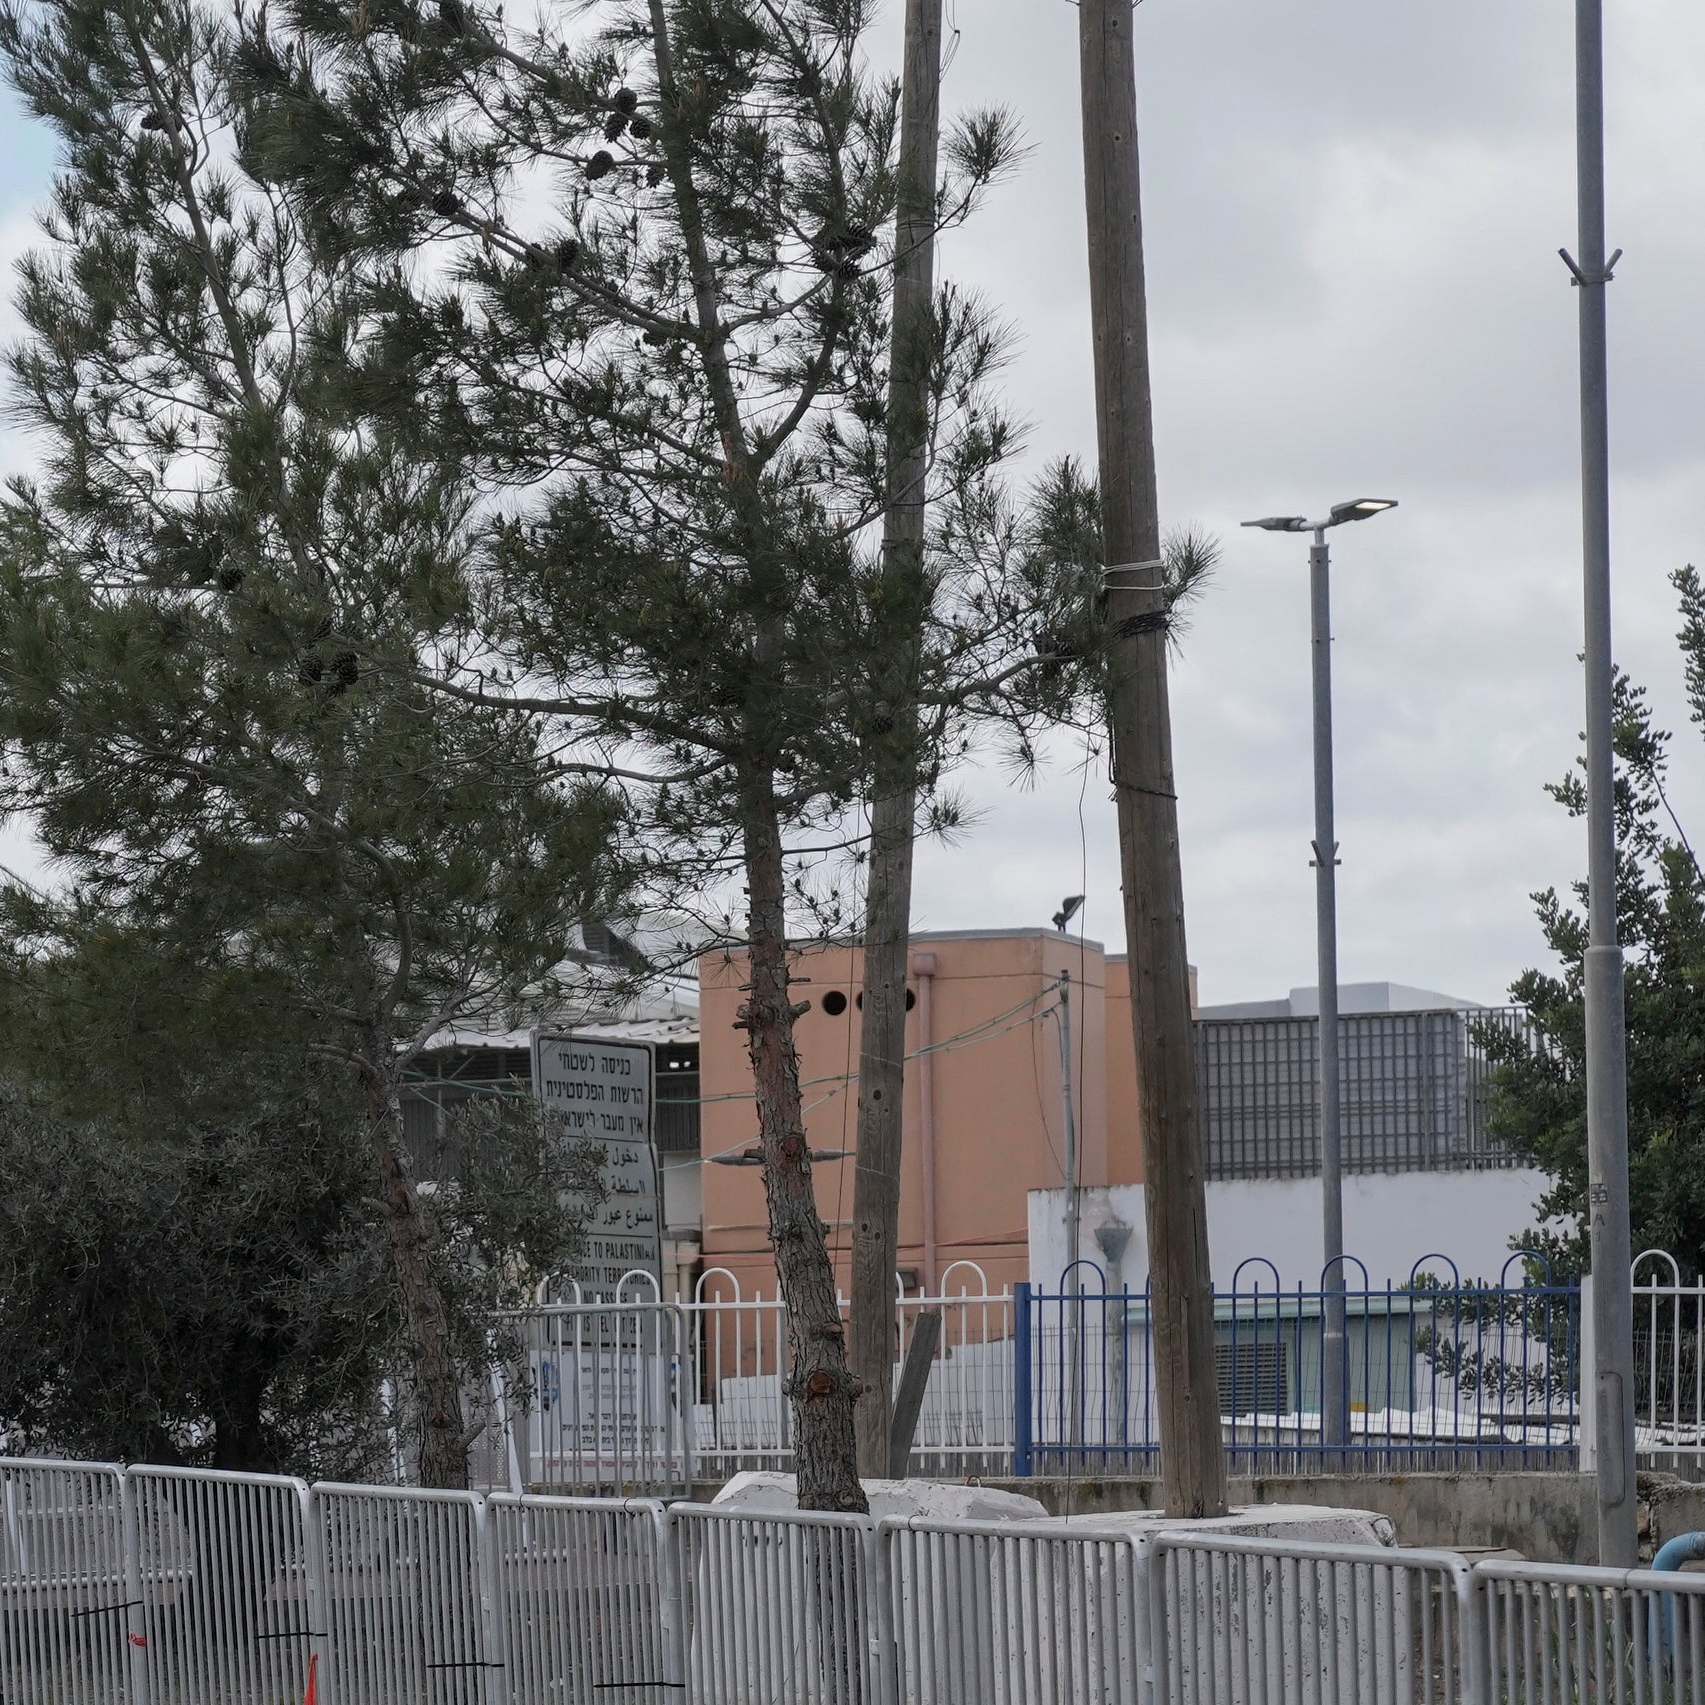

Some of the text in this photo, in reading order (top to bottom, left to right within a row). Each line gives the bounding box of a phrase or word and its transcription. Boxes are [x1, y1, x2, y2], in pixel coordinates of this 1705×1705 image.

[559, 1052, 631, 1075] כניסה לשטחי
[546, 1080, 644, 1105] הרשות הפלסטינית
[563, 1109, 644, 1136] אין מעבר לישרא
[612, 1147, 639, 1167] دخول
[603, 1209, 622, 1225] عبور
[626, 1207, 654, 1230] ممنوع
[594, 1241, 603, 1258] TO
